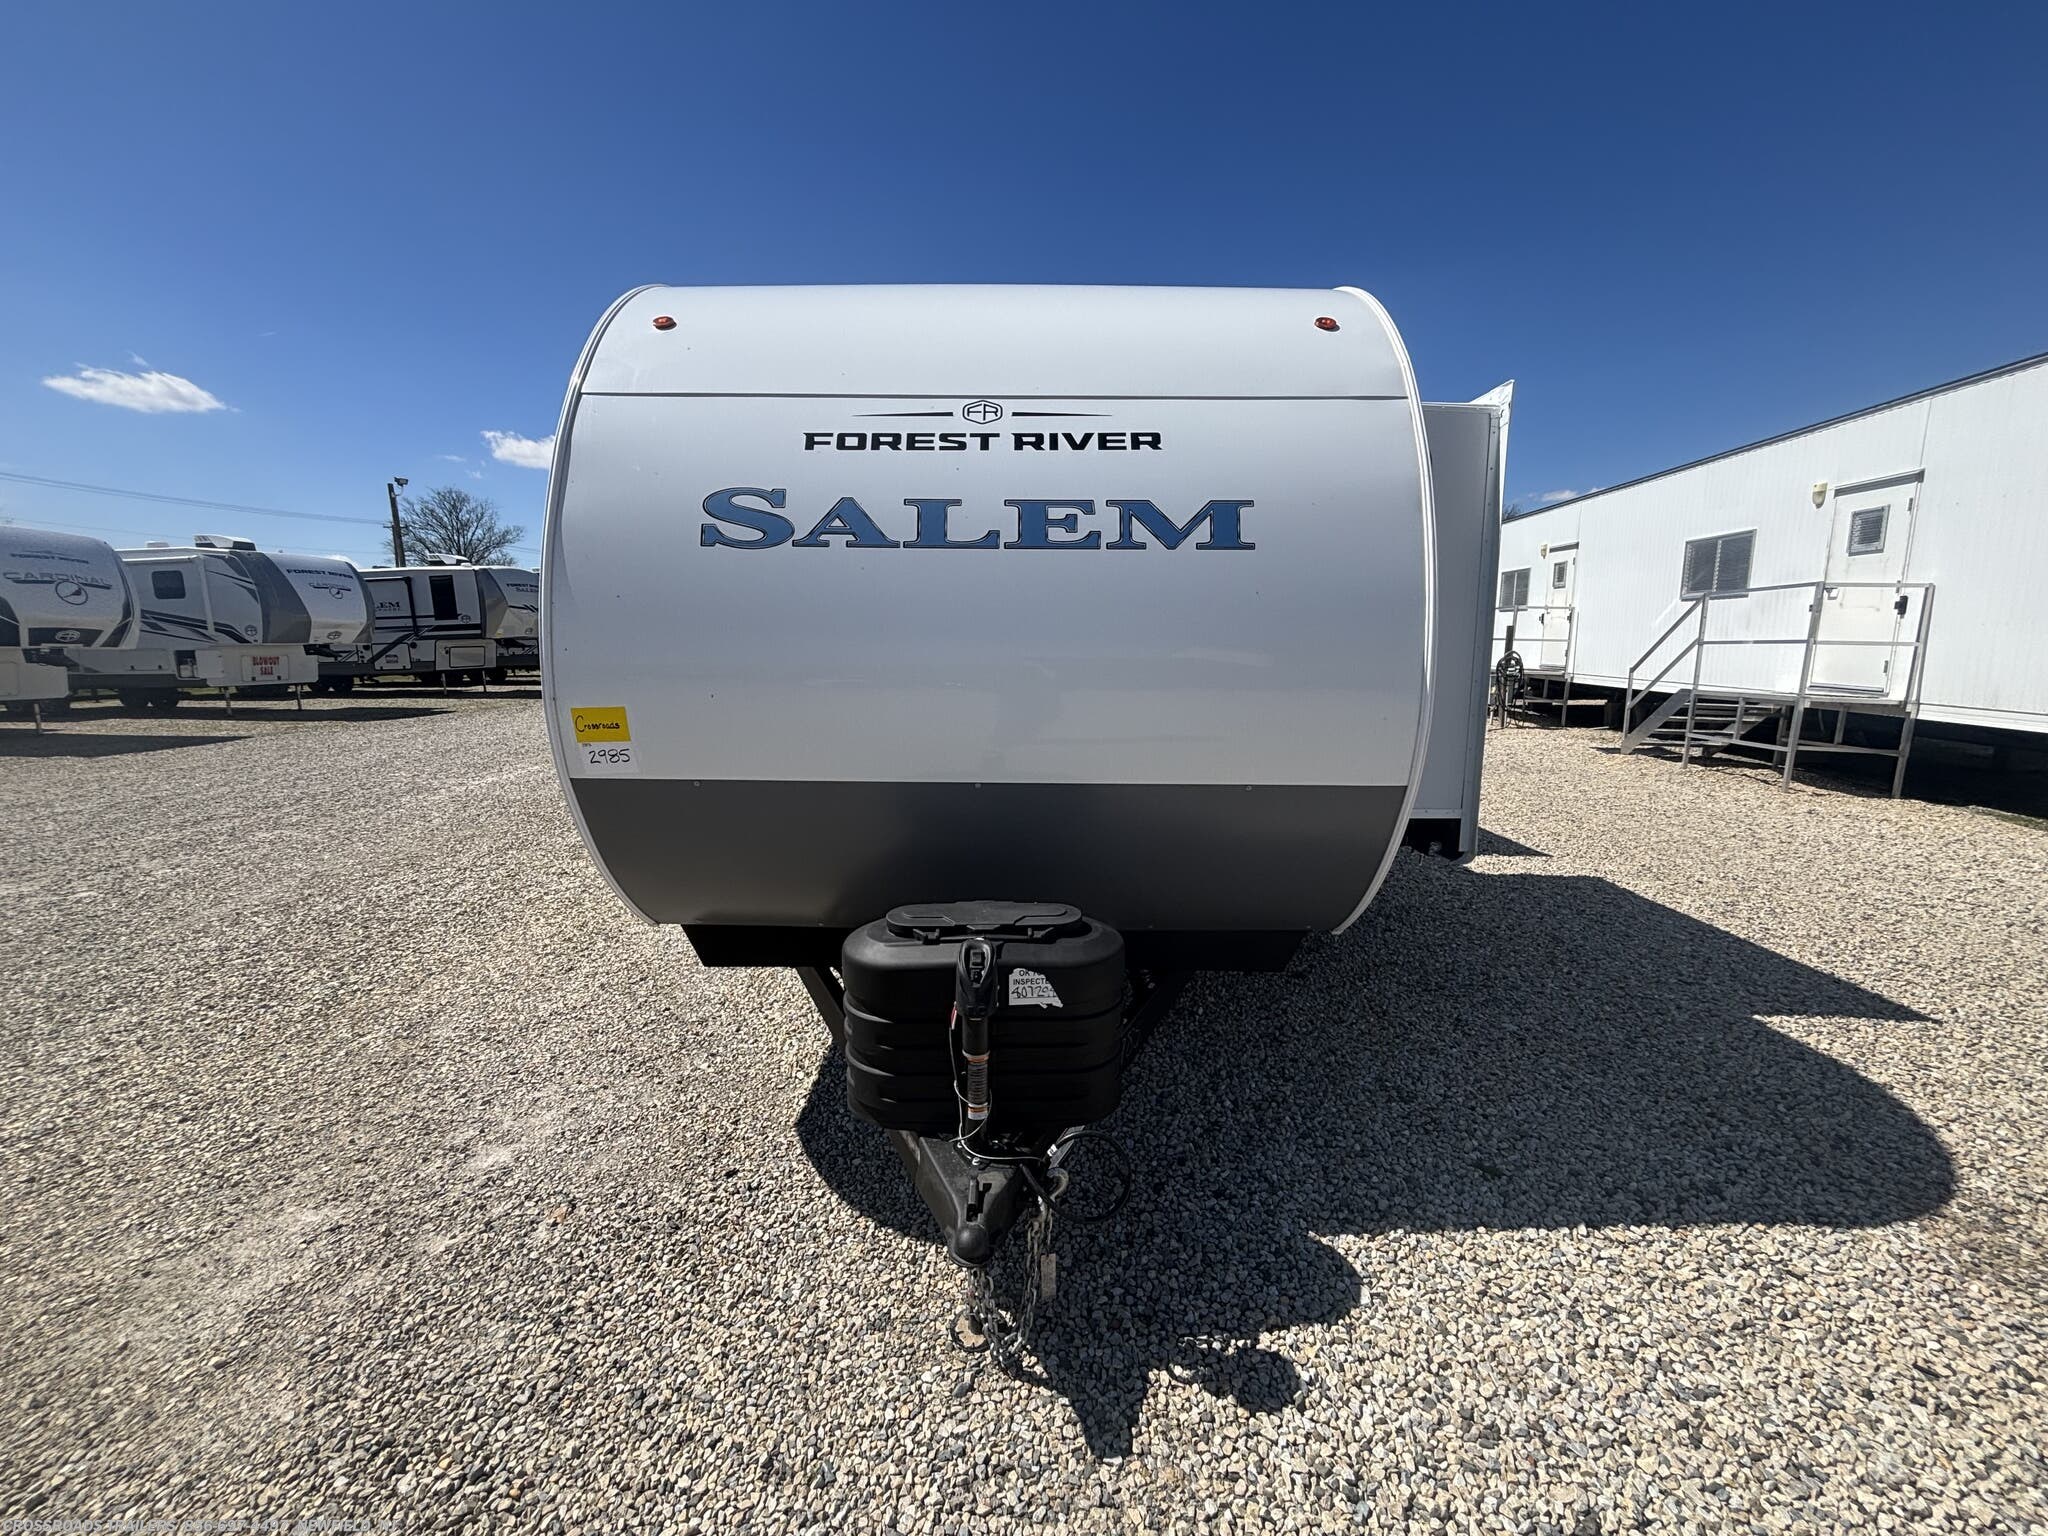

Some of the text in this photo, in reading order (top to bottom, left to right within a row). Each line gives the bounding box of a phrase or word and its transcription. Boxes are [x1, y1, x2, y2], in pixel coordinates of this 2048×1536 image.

[803, 431, 1165, 451] FOREST RIVER
[700, 486, 1256, 550] SALEM
[3, 571, 112, 587] CARDINAL
[286, 568, 326, 576] FOREST
[252, 655, 280, 666] BLOWOUT
[260, 666, 274, 676] SALE
[575, 715, 620, 733] Crossroads
[588, 748, 631, 765] 2985
